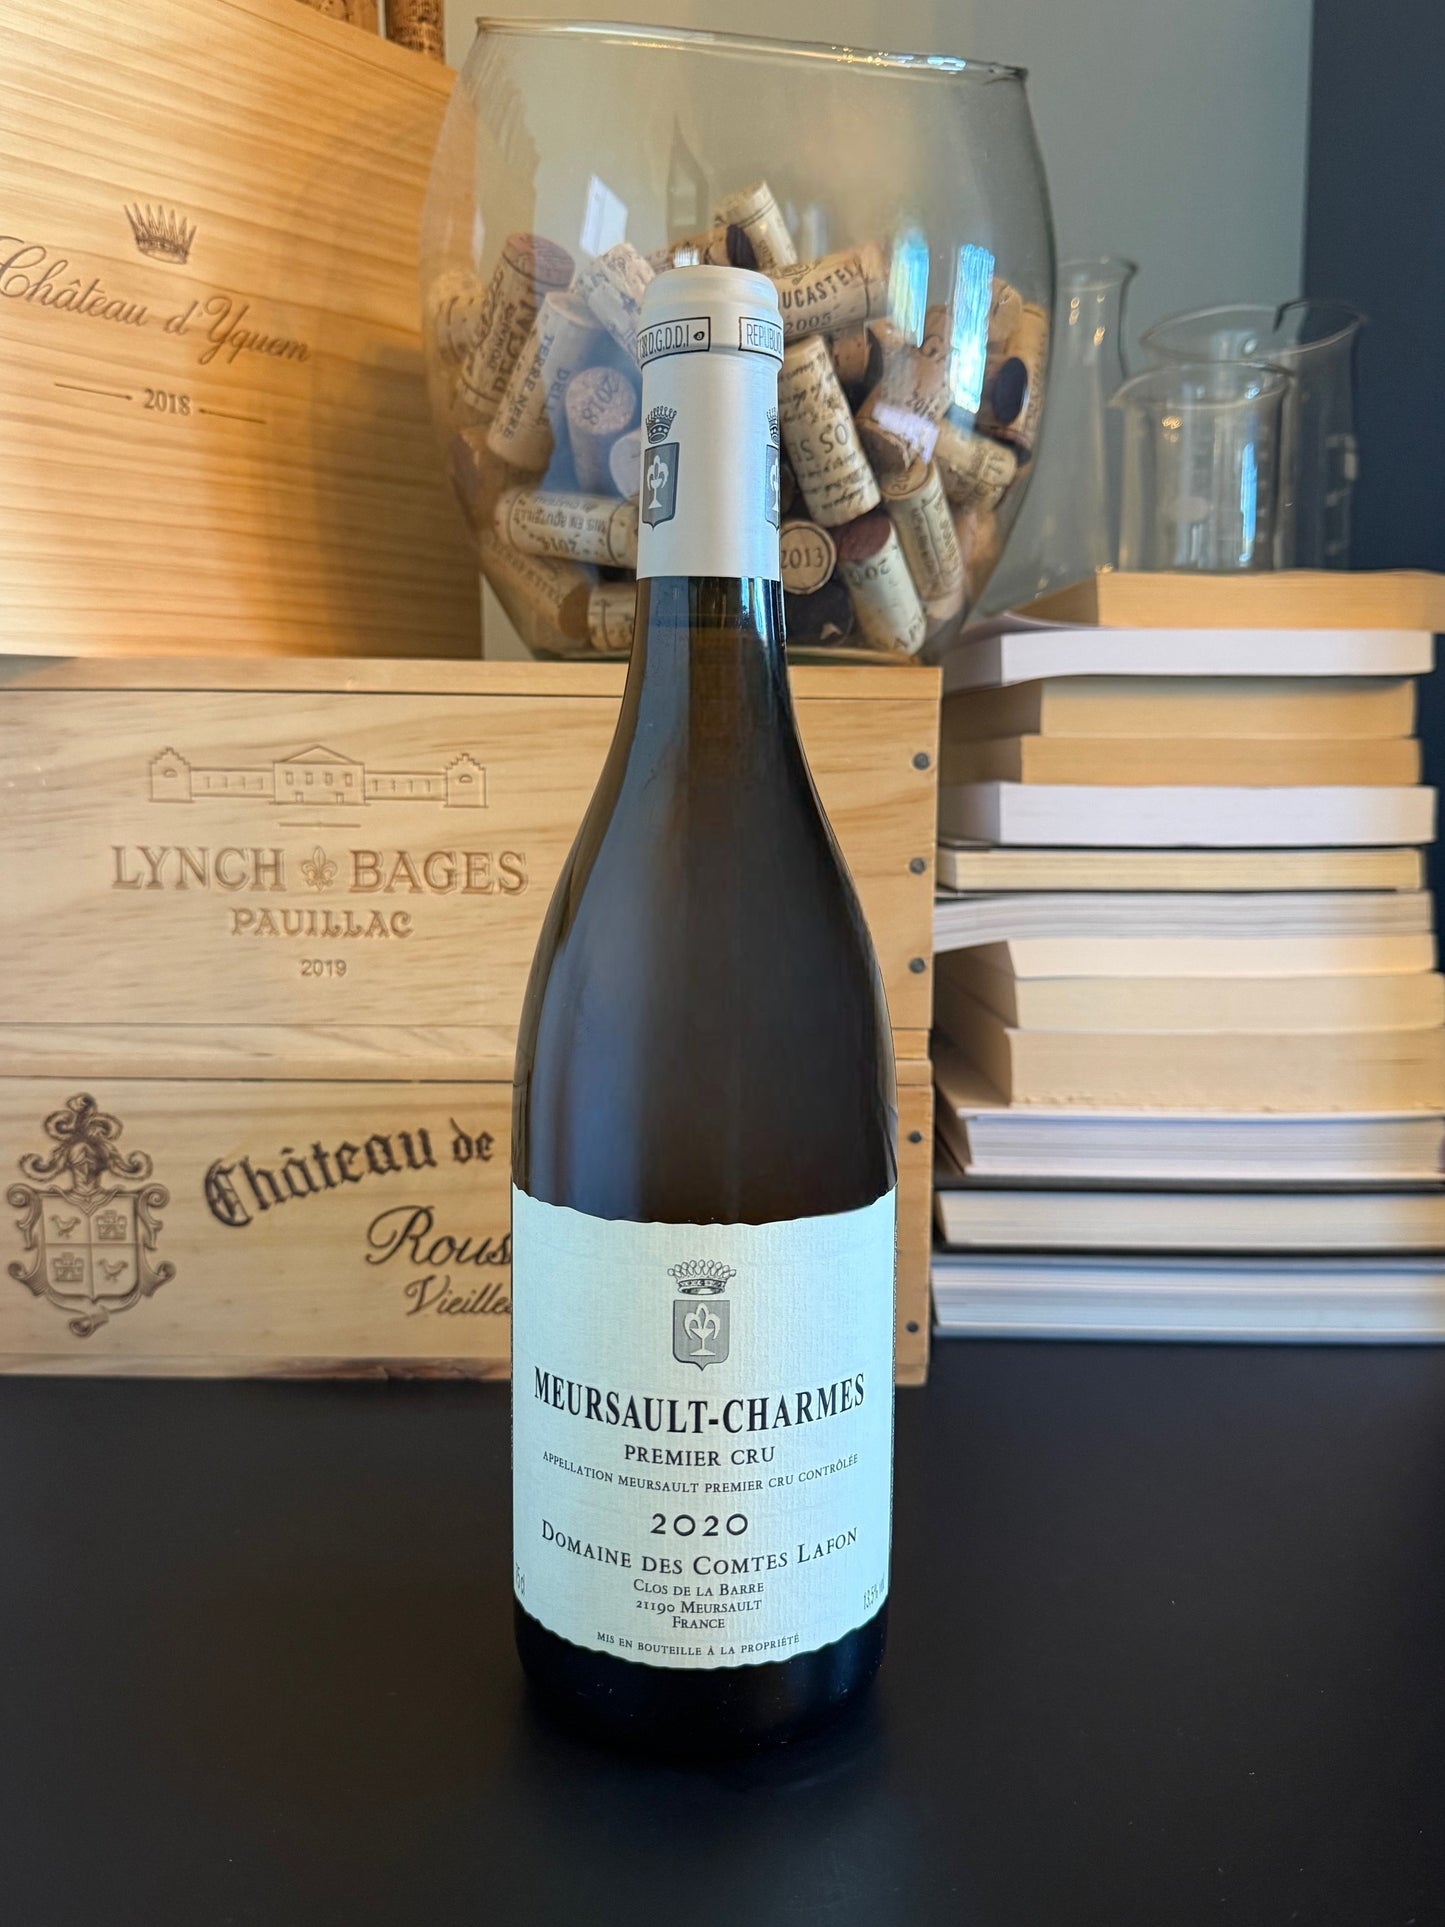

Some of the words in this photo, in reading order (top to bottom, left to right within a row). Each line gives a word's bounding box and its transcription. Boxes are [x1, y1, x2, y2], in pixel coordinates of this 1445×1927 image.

[0, 235, 147, 326] Château
[784, 312, 832, 335] 2005
[524, 335, 556, 391] TERRE
[144, 388, 191, 417] 2018
[781, 547, 823, 569] 2013
[111, 845, 286, 891] LYNCH
[349, 849, 529, 896] BAGES
[231, 906, 413, 938] PAUILLAC
[301, 959, 347, 977] 2019
[204, 1126, 437, 1228] Château
[449, 1117, 495, 1164] de
[534, 1366, 865, 1433] MEURSAULT-CHARMES
[624, 1443, 722, 1467] PREMIER
[730, 1445, 776, 1465] CRU
[542, 1450, 613, 1483] APPELLATION
[618, 1474, 699, 1493] MEURSAULT
[704, 1478, 764, 1494] PREMIER
[768, 1474, 794, 1489] CRU
[798, 1453, 859, 1483] CONTRÔLÉE
[650, 1513, 749, 1537] 2020
[641, 1555, 683, 1576] DES
[673, 1585, 692, 1597] DE
[696, 1586, 713, 1598] LA
[636, 1600, 675, 1616] 21190
[596, 1631, 615, 1645] MIS
[619, 1637, 633, 1649] EN
[637, 1641, 702, 1656] BOUTEILLE
[719, 1643, 735, 1656] LA
[740, 1633, 801, 1653] PROPRIÉTÉ
